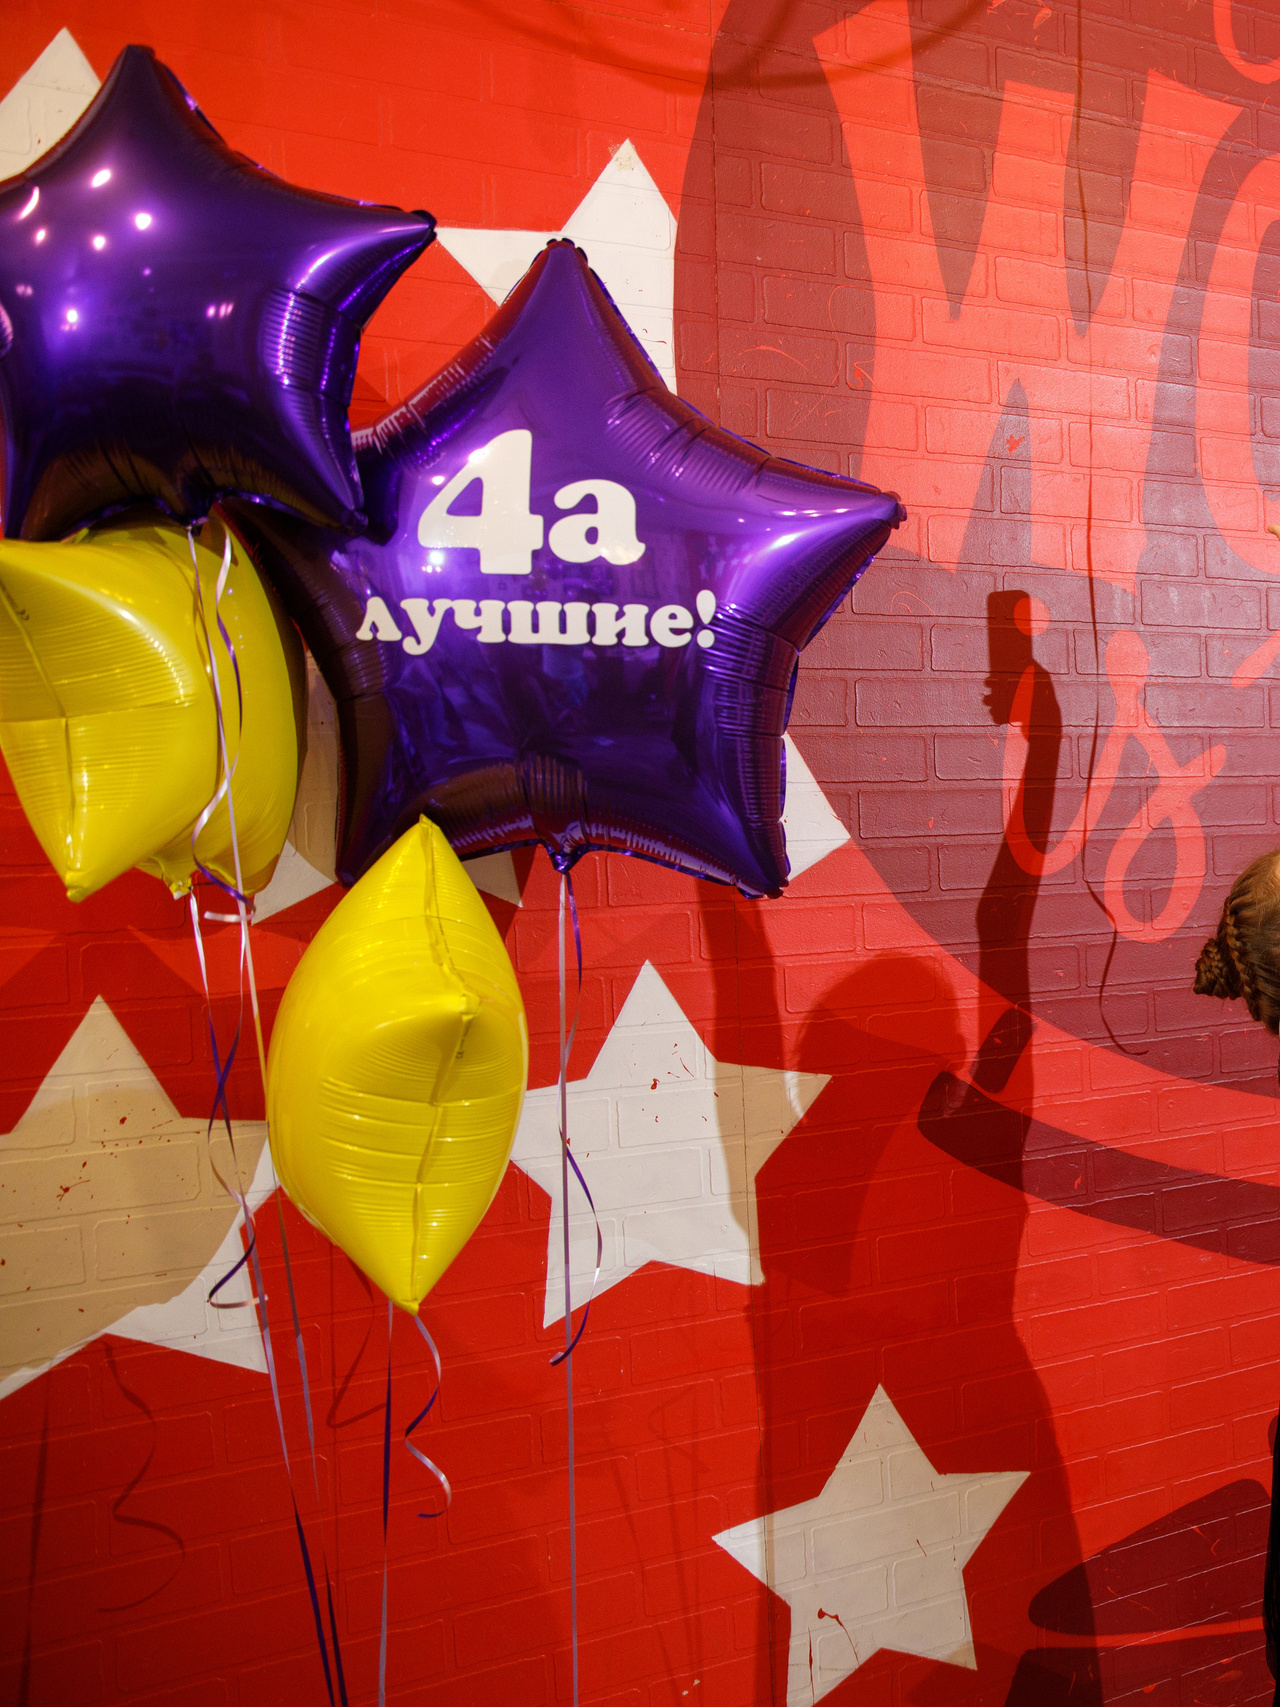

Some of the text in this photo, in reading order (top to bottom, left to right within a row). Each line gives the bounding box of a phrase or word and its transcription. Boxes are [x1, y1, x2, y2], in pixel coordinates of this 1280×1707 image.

[417, 429, 646, 575] 4а
[356, 589, 717, 656] лучшие!
[1002, 596, 1227, 942] is
